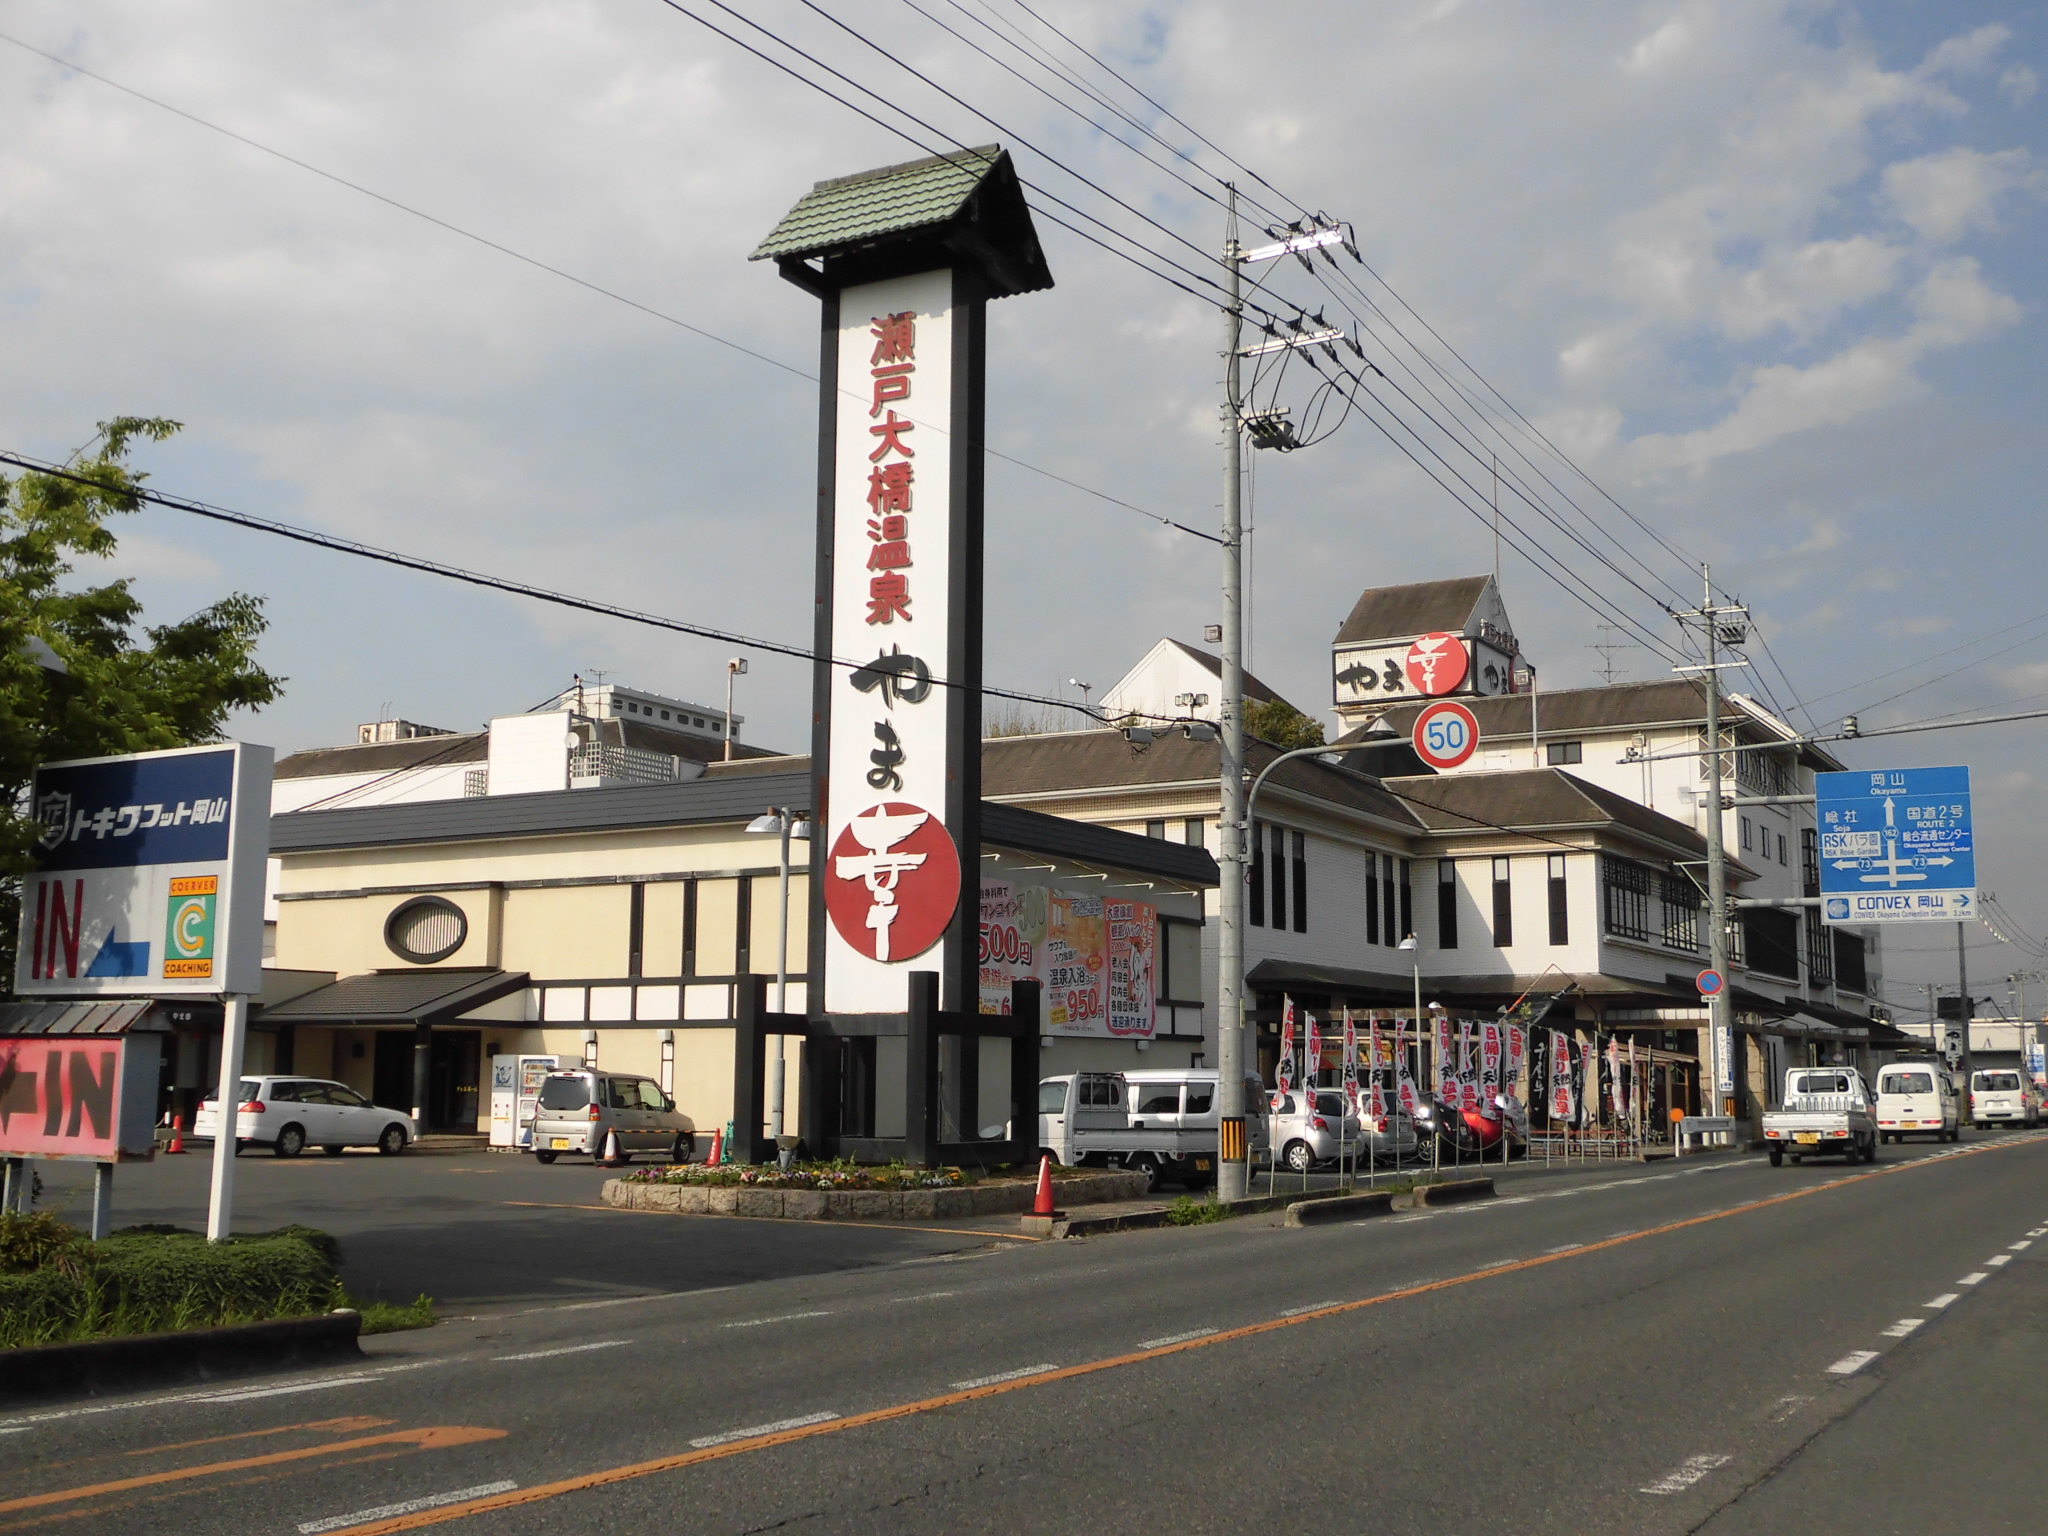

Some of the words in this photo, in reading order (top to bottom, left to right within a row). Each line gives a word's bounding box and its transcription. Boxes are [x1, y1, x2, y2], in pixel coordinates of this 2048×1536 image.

[866, 311, 917, 626] 瀬戸大橋温泉
[1428, 720, 1464, 751] 50
[1871, 773, 1904, 786] 岡山
[1870, 787, 1907, 796] Okayama
[1825, 810, 1858, 823] 総社
[1907, 805, 1964, 820] 国道2号
[70, 797, 228, 842] トキワフット岡山
[1917, 821, 1945, 829] ROUTE
[1949, 820, 1955, 828] 2
[1833, 825, 1851, 833] Soja
[1884, 829, 1897, 837] 162
[1860, 859, 1871, 868] 73
[1914, 857, 1925, 866] 73
[171, 878, 216, 893] COERVER
[1857, 896, 1911, 910] CONVEX
[1918, 895, 1943, 907] 岡山
[1855, 911, 1875, 919] CONVEX
[1876, 910, 1900, 919] Okayama
[32, 879, 84, 979] IN
[165, 962, 211, 974] COACHING
[43, 1051, 116, 1140] IN
